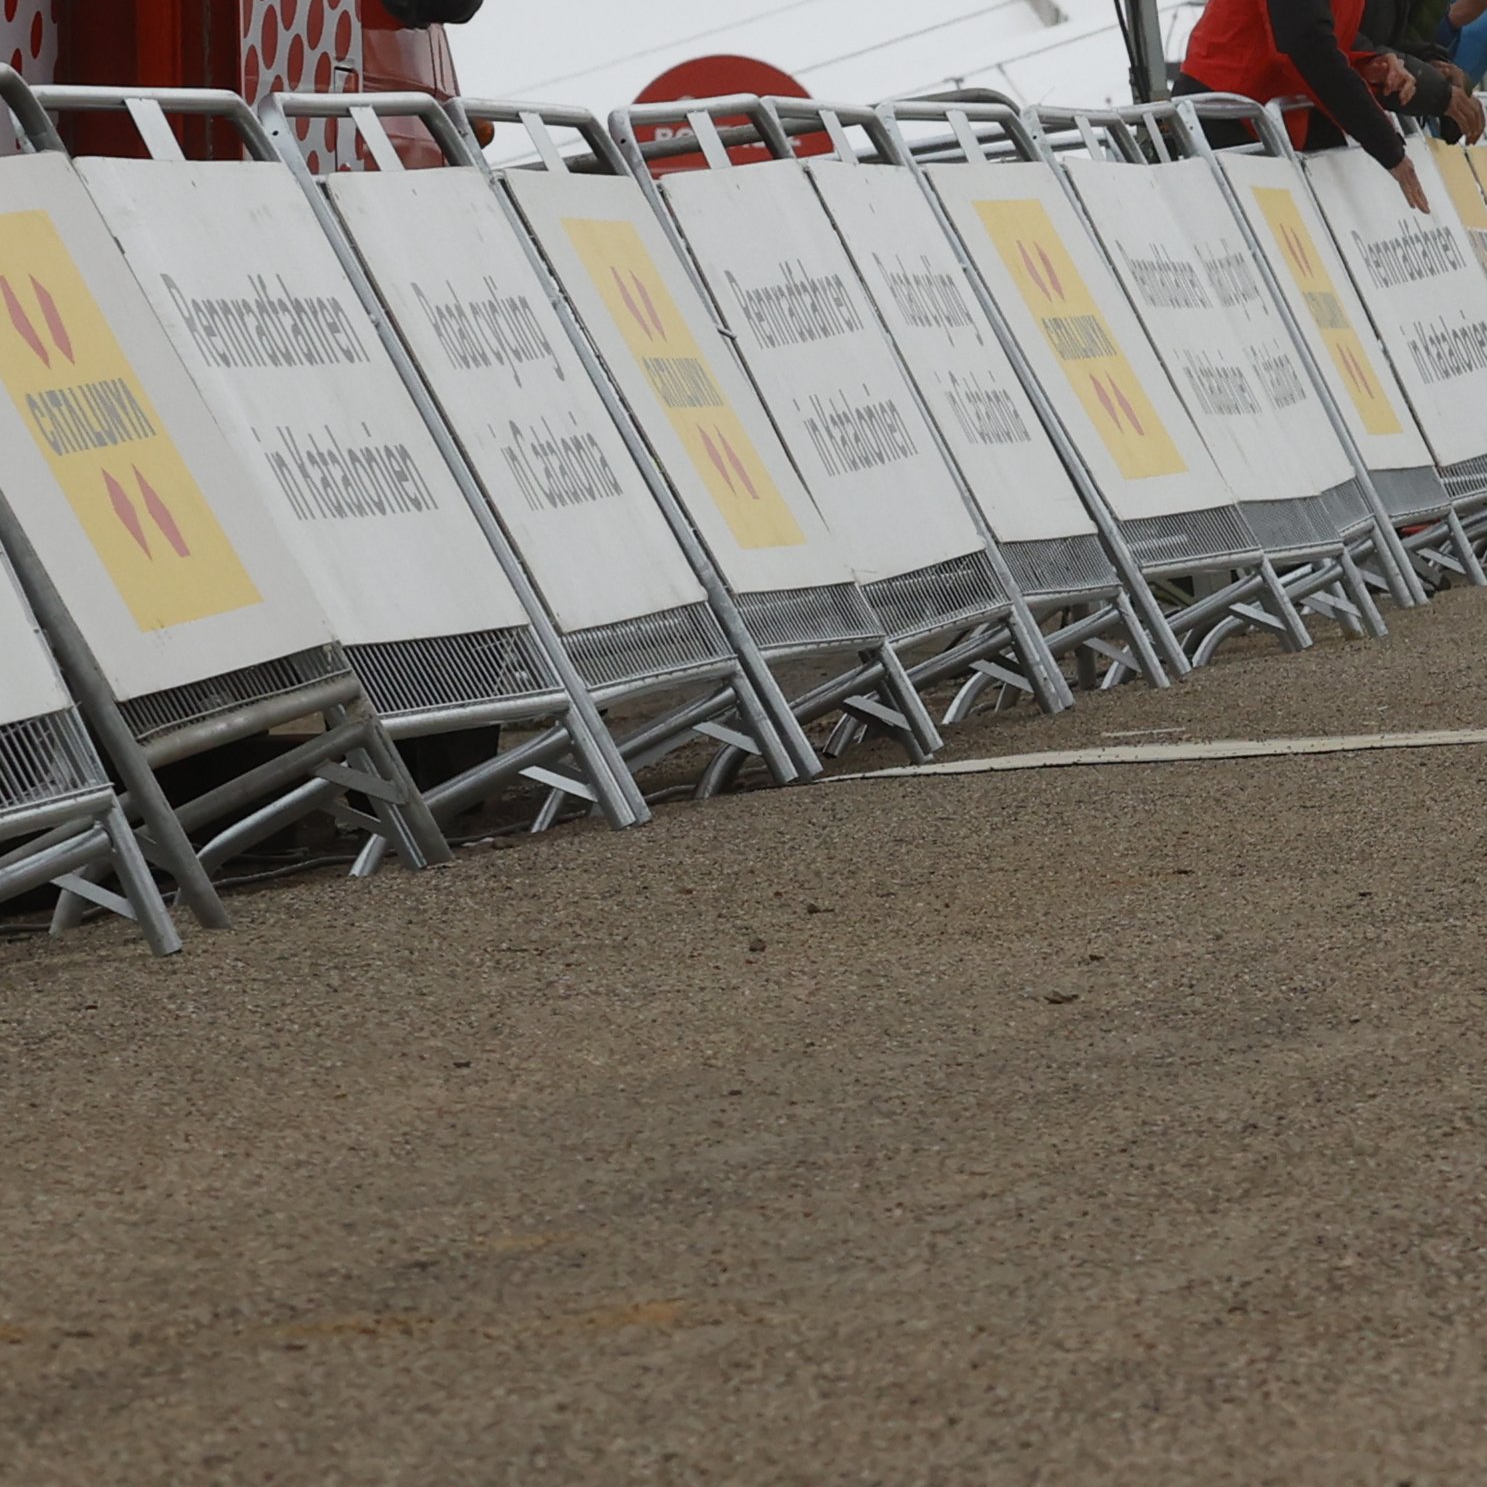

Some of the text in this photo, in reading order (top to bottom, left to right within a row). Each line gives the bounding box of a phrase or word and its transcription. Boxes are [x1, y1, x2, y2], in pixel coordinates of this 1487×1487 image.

[160, 273, 371, 369] Rennradfahren
[25, 377, 157, 456] CATALUNYA
[276, 421, 439, 520] Katalonien
[508, 411, 624, 509] Catalonia
